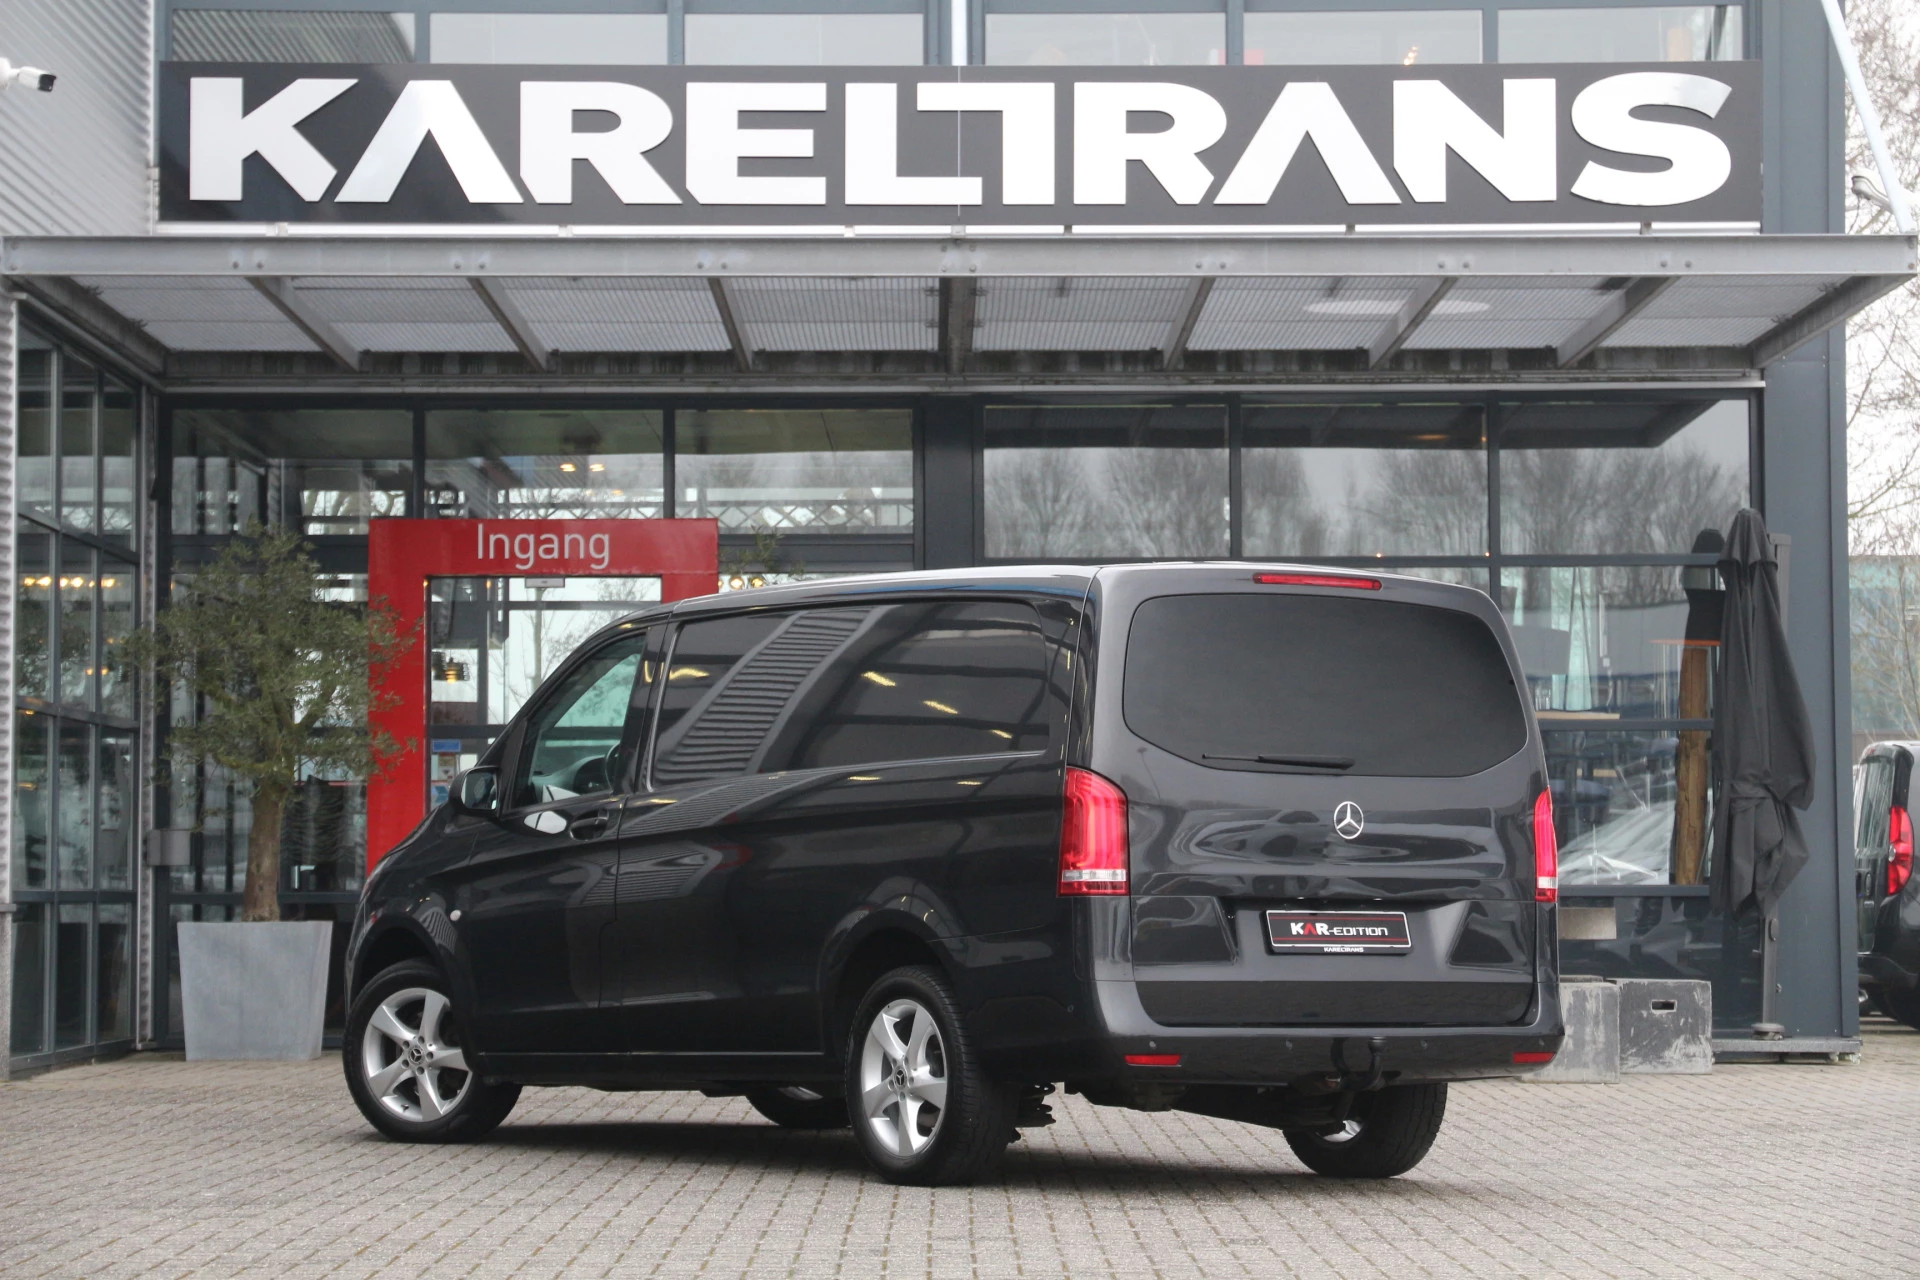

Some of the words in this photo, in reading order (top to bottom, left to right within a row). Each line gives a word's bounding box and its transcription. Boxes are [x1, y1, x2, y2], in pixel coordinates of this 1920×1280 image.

[189, 72, 1733, 206] KARELTRANS
[477, 523, 610, 570] Ingang
[1290, 922, 1388, 936] KAR-EDITION
